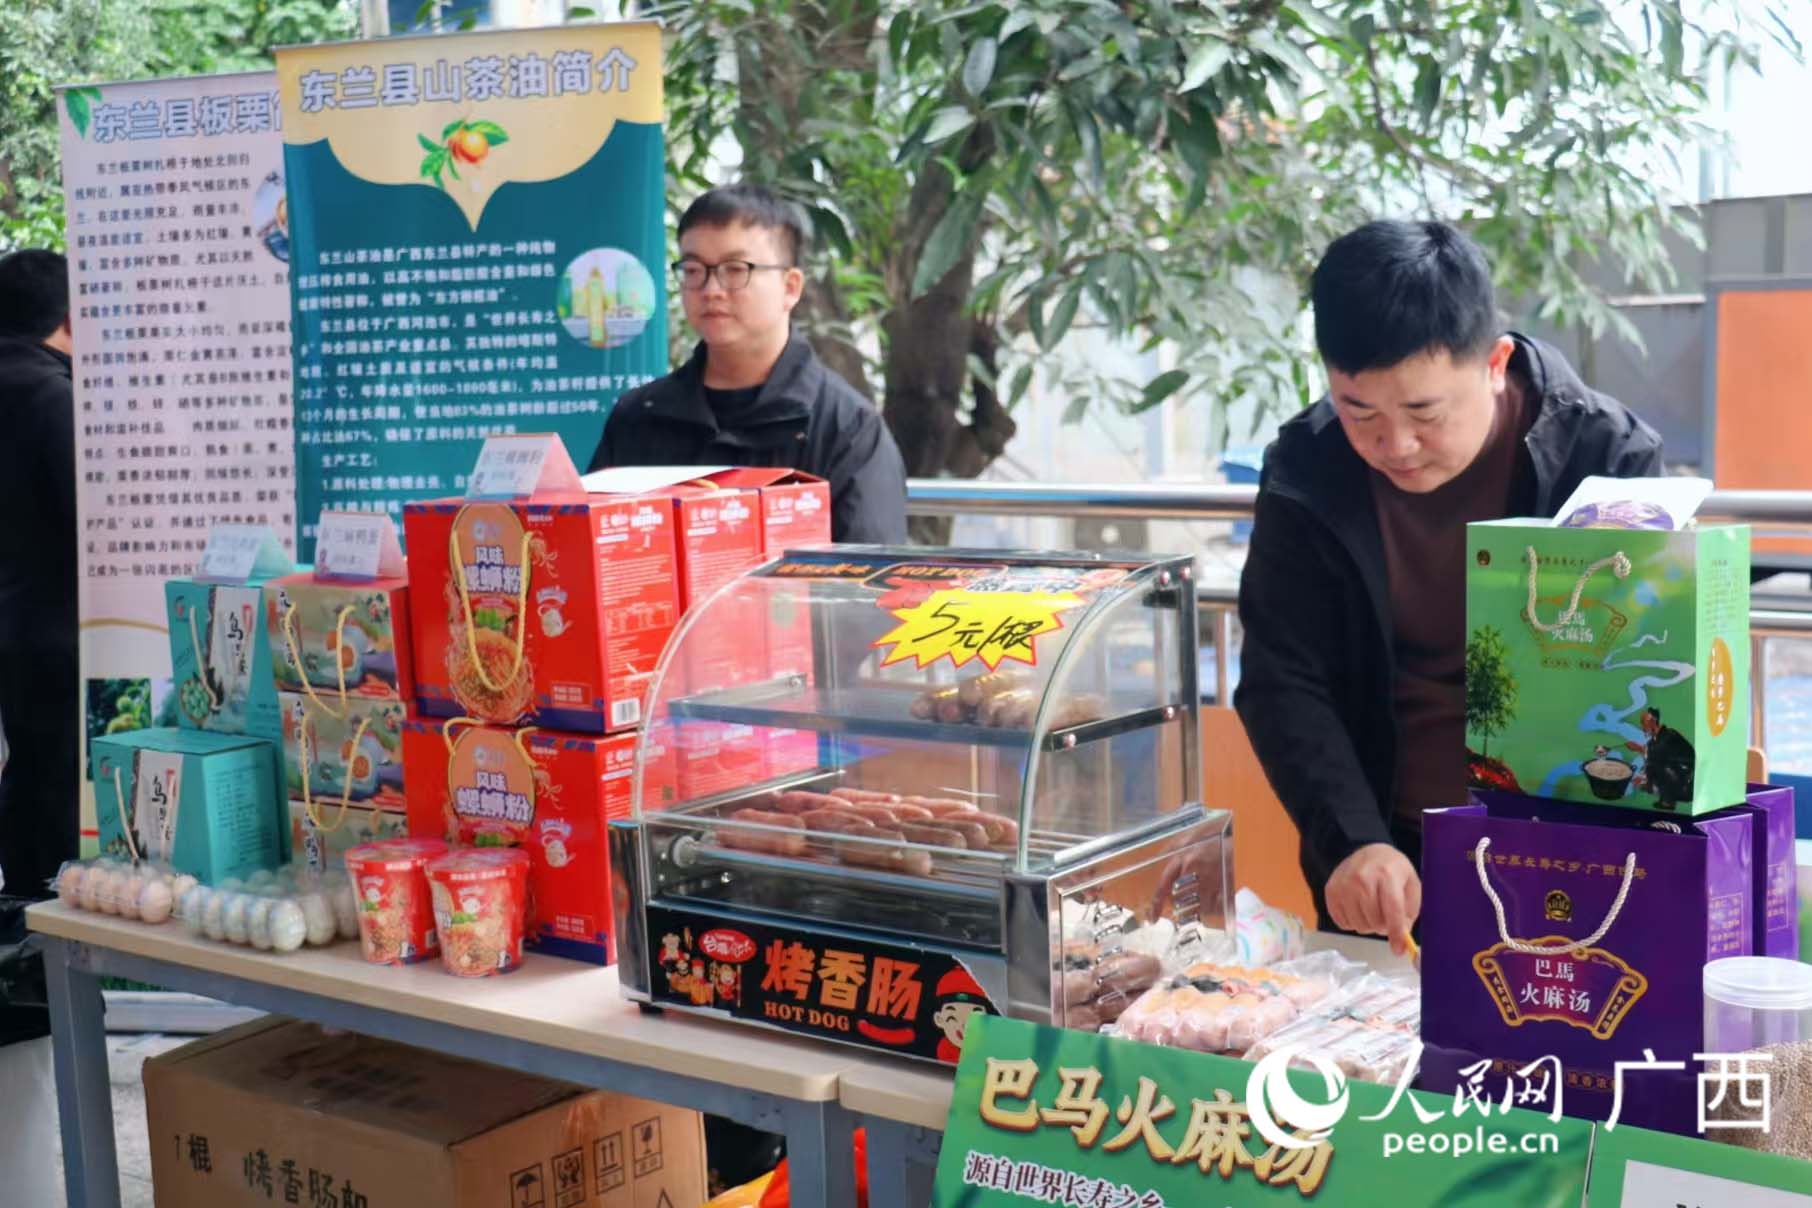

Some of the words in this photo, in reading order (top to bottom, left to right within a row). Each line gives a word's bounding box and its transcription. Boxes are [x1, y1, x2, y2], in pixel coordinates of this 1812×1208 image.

[300, 47, 638, 113] 东兰县山茶油简介
[760, 938, 923, 1022] 烤香肠
[1535, 958, 1576, 982] 巴馬
[1519, 982, 1592, 1014] 火麻汤
[764, 1001, 804, 1023] HOT
[809, 1009, 850, 1032] DOG
